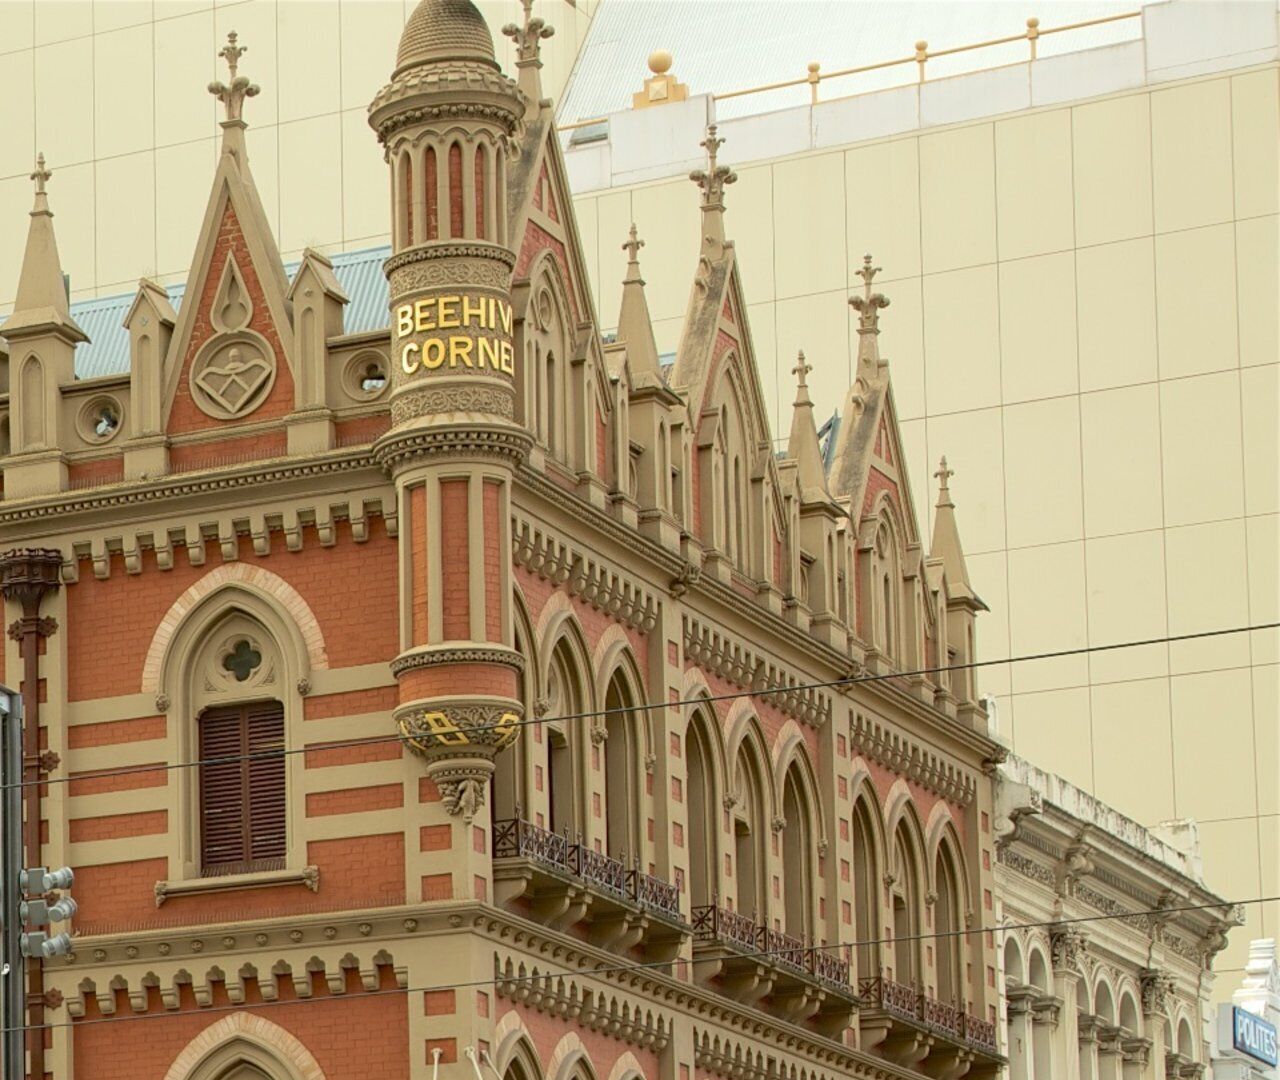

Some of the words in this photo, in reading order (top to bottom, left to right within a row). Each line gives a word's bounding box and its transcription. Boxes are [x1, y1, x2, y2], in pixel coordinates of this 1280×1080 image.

[397, 295, 513, 338] BEEHIV
[402, 336, 515, 377] CORNE
[1237, 1014, 1277, 1058] POLITES
